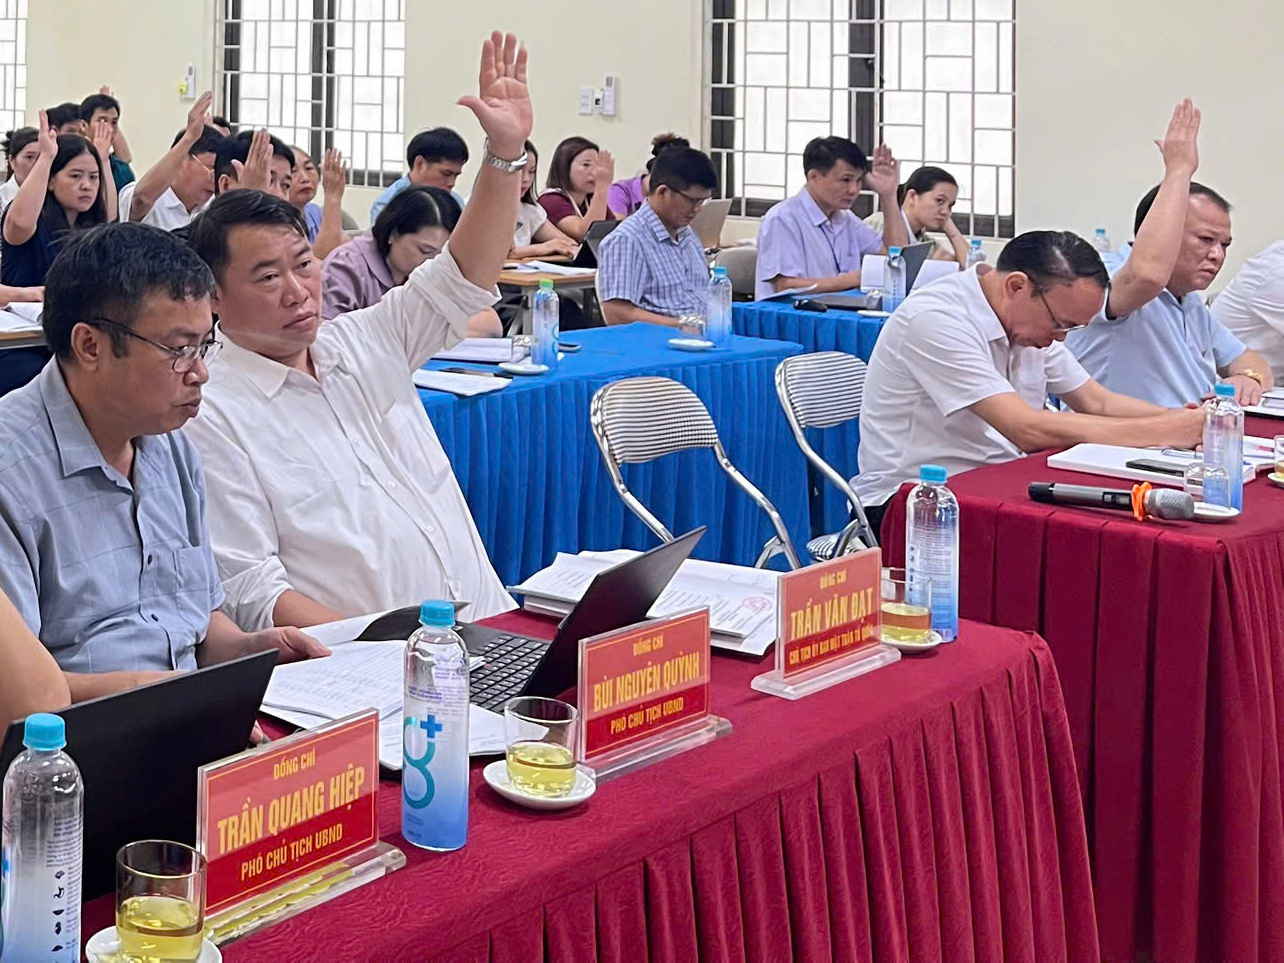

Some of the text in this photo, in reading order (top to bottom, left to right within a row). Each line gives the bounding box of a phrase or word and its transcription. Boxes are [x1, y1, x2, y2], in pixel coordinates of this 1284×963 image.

[825, 593, 848, 629] VĂN
[593, 675, 613, 713] BÙI
[663, 650, 700, 691] QUỲNH
[645, 703, 662, 724] TỊCH
[663, 697, 684, 715] UBND
[301, 747, 316, 769] CHÍ
[217, 763, 365, 854] TRẦN QUANG HIỆP
[241, 823, 343, 881] PHÓ CHỦ TỊCH UBND
